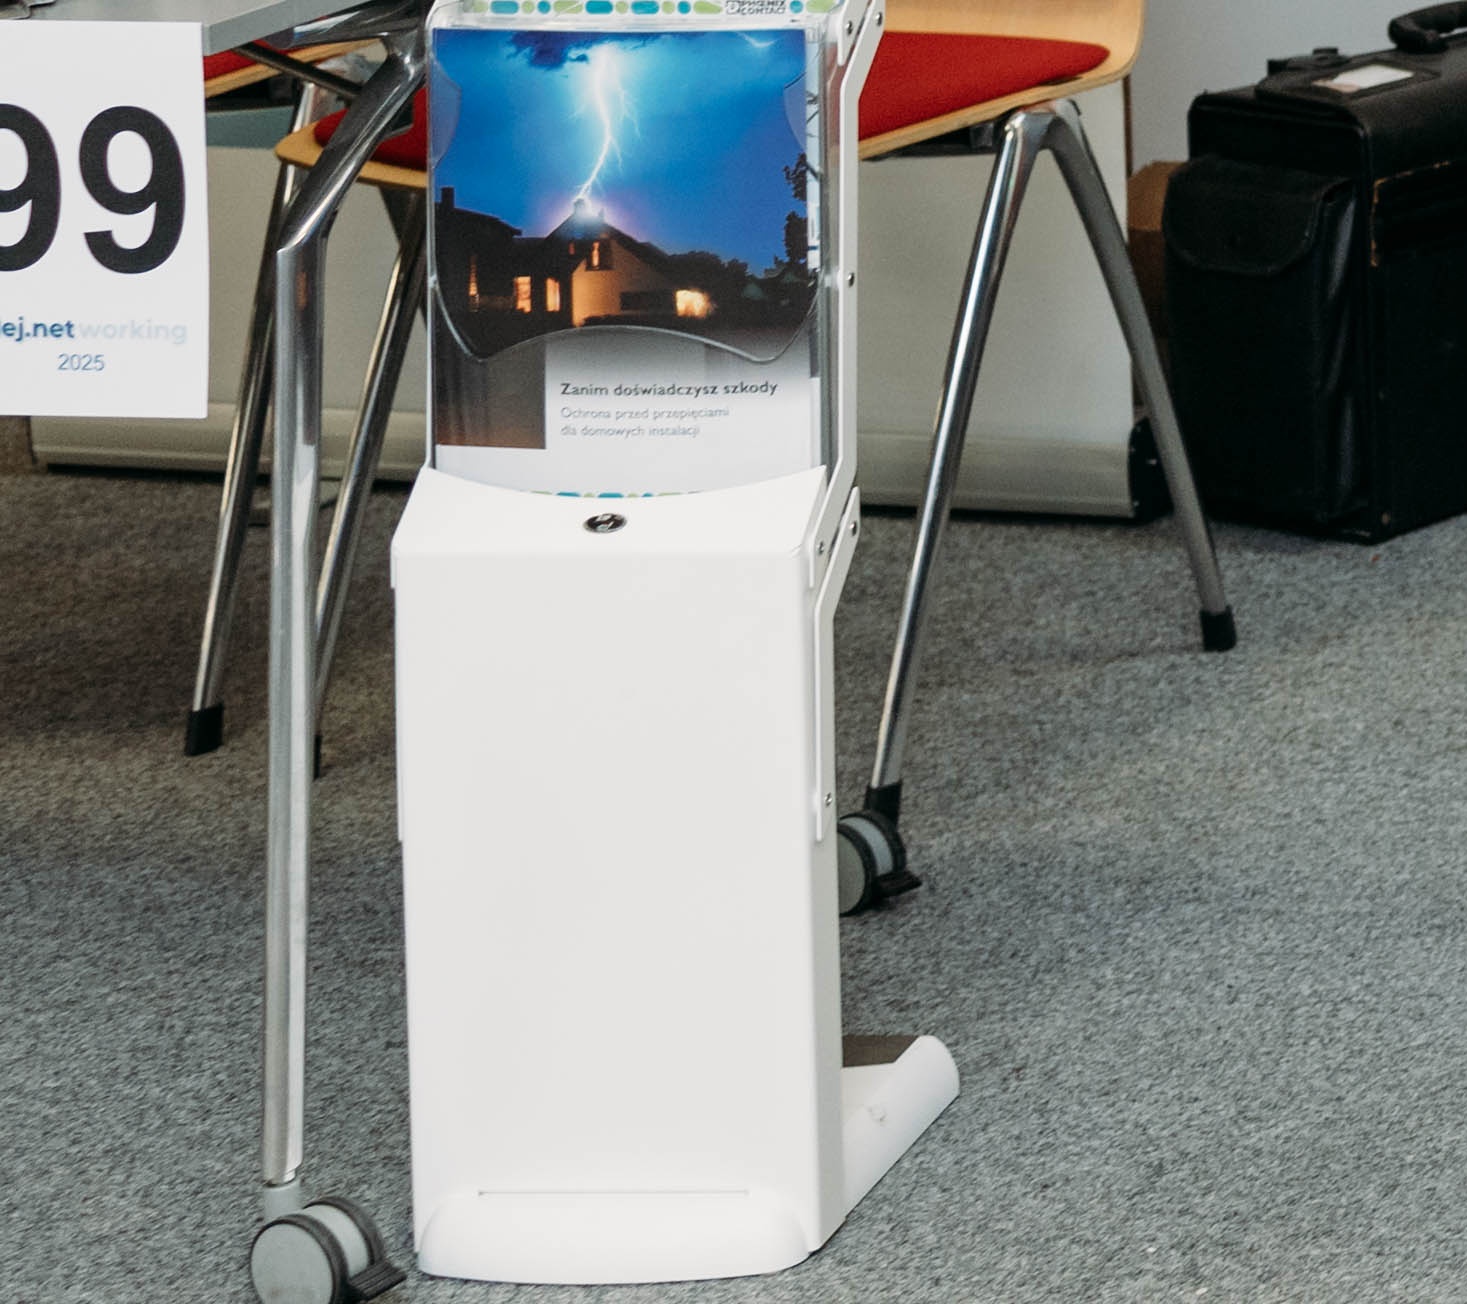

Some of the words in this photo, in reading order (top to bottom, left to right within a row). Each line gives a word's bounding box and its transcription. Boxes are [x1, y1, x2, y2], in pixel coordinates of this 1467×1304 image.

[57, 353, 105, 371] 2025
[561, 383, 609, 396] Zanim
[614, 383, 718, 398] doświadczysz
[723, 381, 778, 396] szkody
